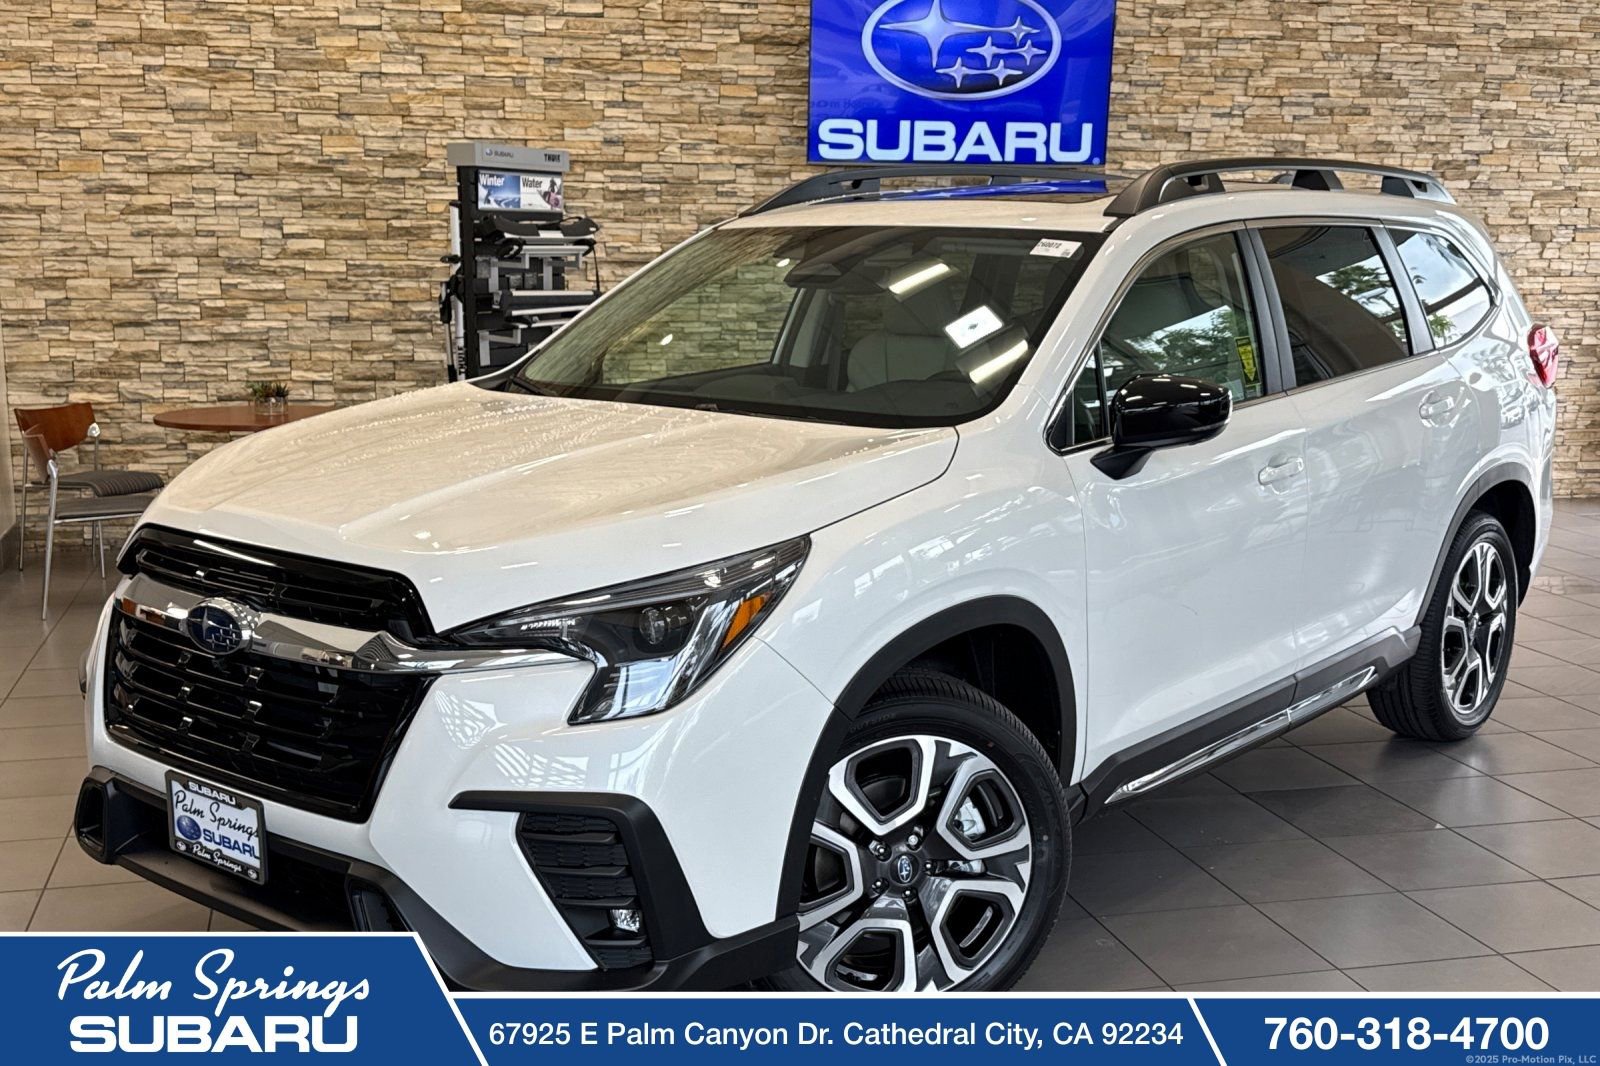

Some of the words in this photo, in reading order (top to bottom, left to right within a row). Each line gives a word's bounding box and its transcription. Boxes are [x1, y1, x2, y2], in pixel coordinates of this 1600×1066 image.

[817, 118, 1094, 163] SUBARU
[494, 150, 514, 158] SUBARU
[544, 153, 561, 163] THULE
[479, 173, 505, 187] Winter
[522, 177, 543, 189] Water
[188, 781, 236, 805] SUBARU
[174, 789, 205, 819] Palm
[192, 843, 211, 860] Palm
[213, 851, 243, 873] Springs
